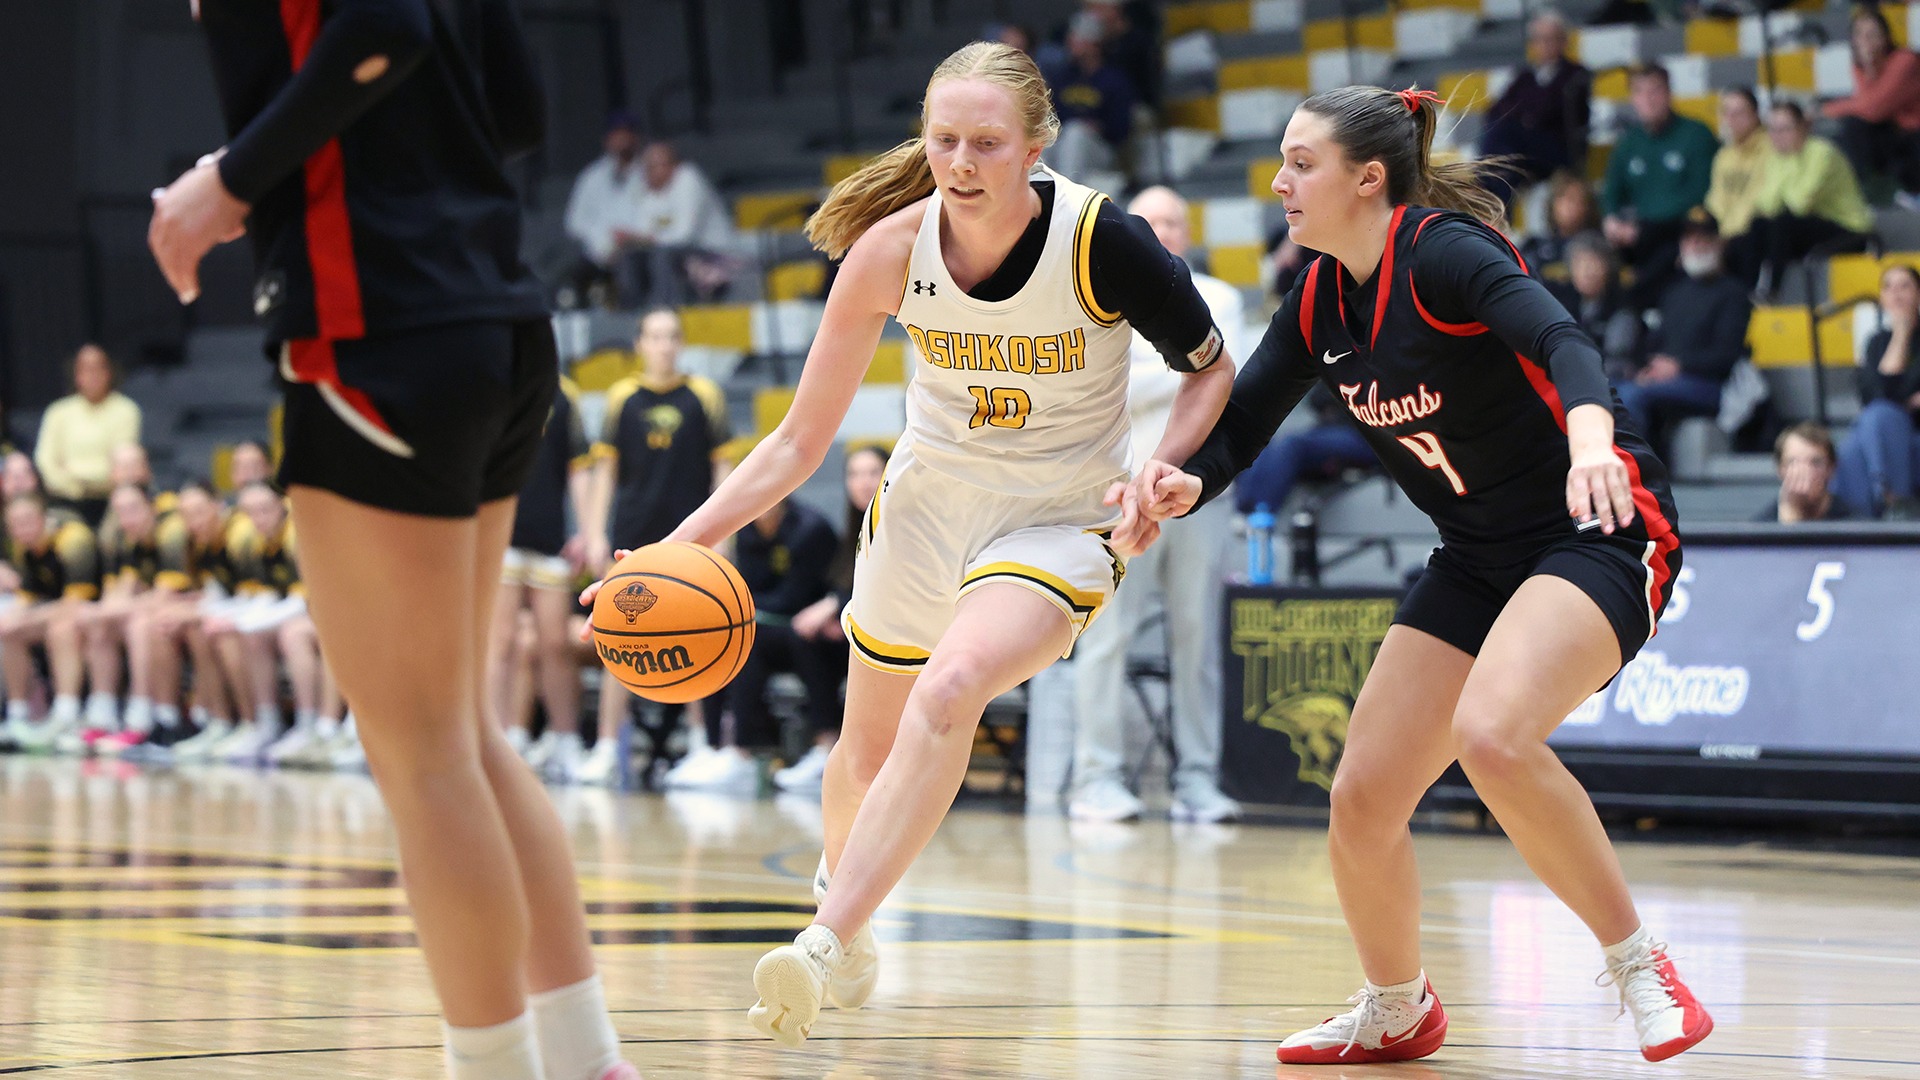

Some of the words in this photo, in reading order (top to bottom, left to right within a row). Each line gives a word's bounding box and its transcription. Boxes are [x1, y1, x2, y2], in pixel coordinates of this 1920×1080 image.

[906, 324, 1086, 375] OSHKOSH
[968, 385, 1032, 430] 10
[1338, 378, 1443, 428] Falcons
[1395, 430, 1468, 496] 4
[1796, 562, 1846, 642] 5
[597, 640, 695, 676] Wilson
[1614, 651, 1749, 727] Rhyme
